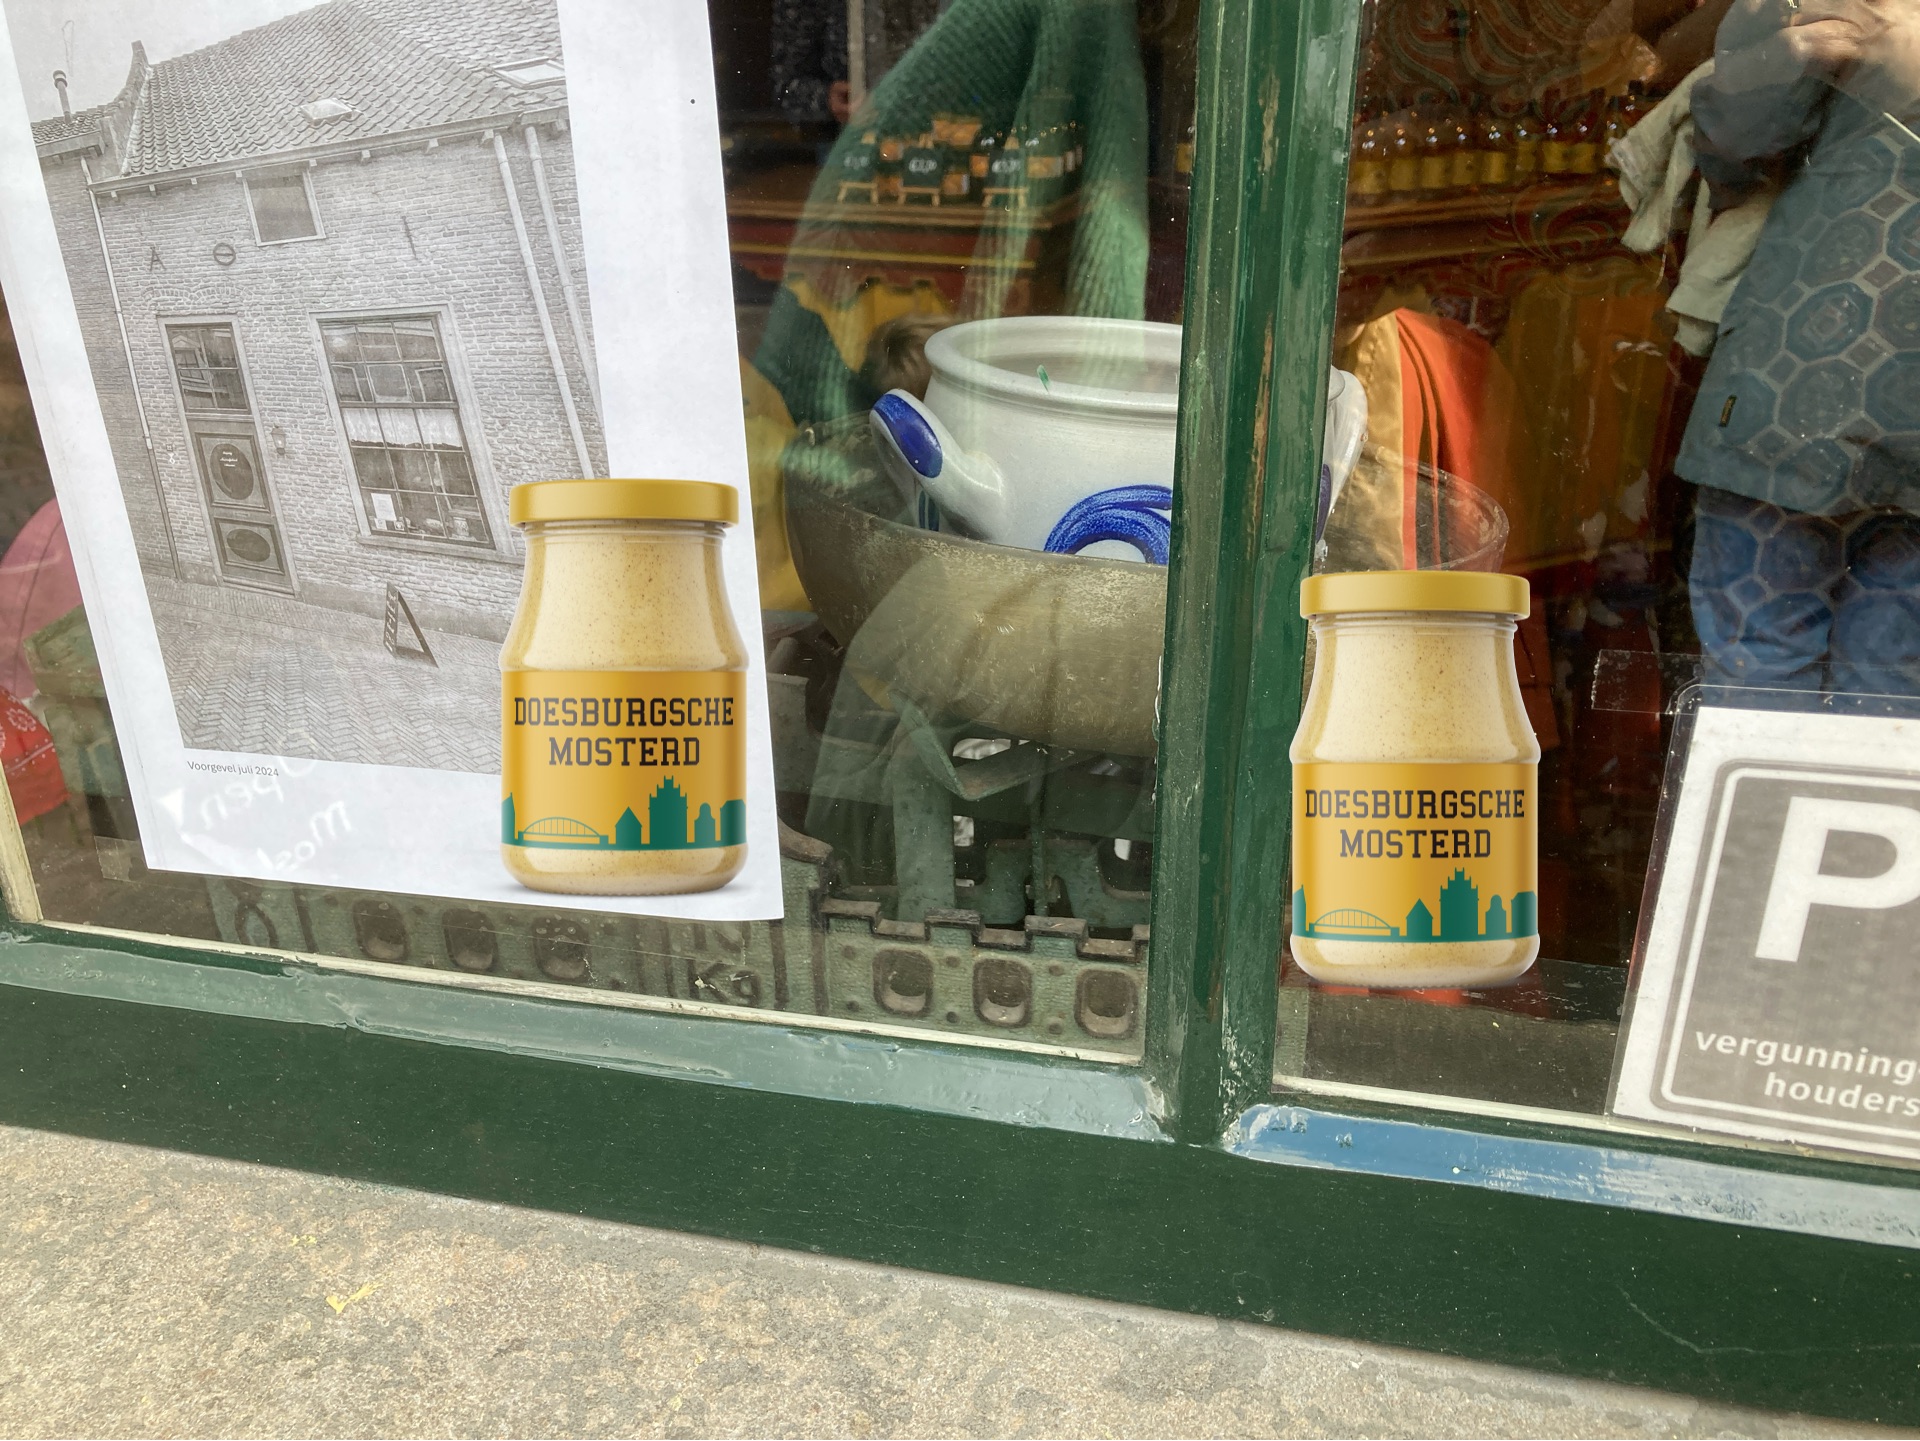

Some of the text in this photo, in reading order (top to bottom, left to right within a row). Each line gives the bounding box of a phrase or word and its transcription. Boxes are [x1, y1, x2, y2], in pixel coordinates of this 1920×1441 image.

[514, 697, 734, 726] DOESBURGSCHE
[549, 737, 700, 766] MOSTERD
[187, 760, 279, 777] Voorgevel juli 2024
[1305, 789, 1525, 818] DOESBURGSCHE
[1340, 829, 1491, 858] MOSTERD
[1755, 796, 1920, 962] P
[1696, 1031, 1920, 1086] vergunning
[1764, 1072, 1920, 1117] houders
